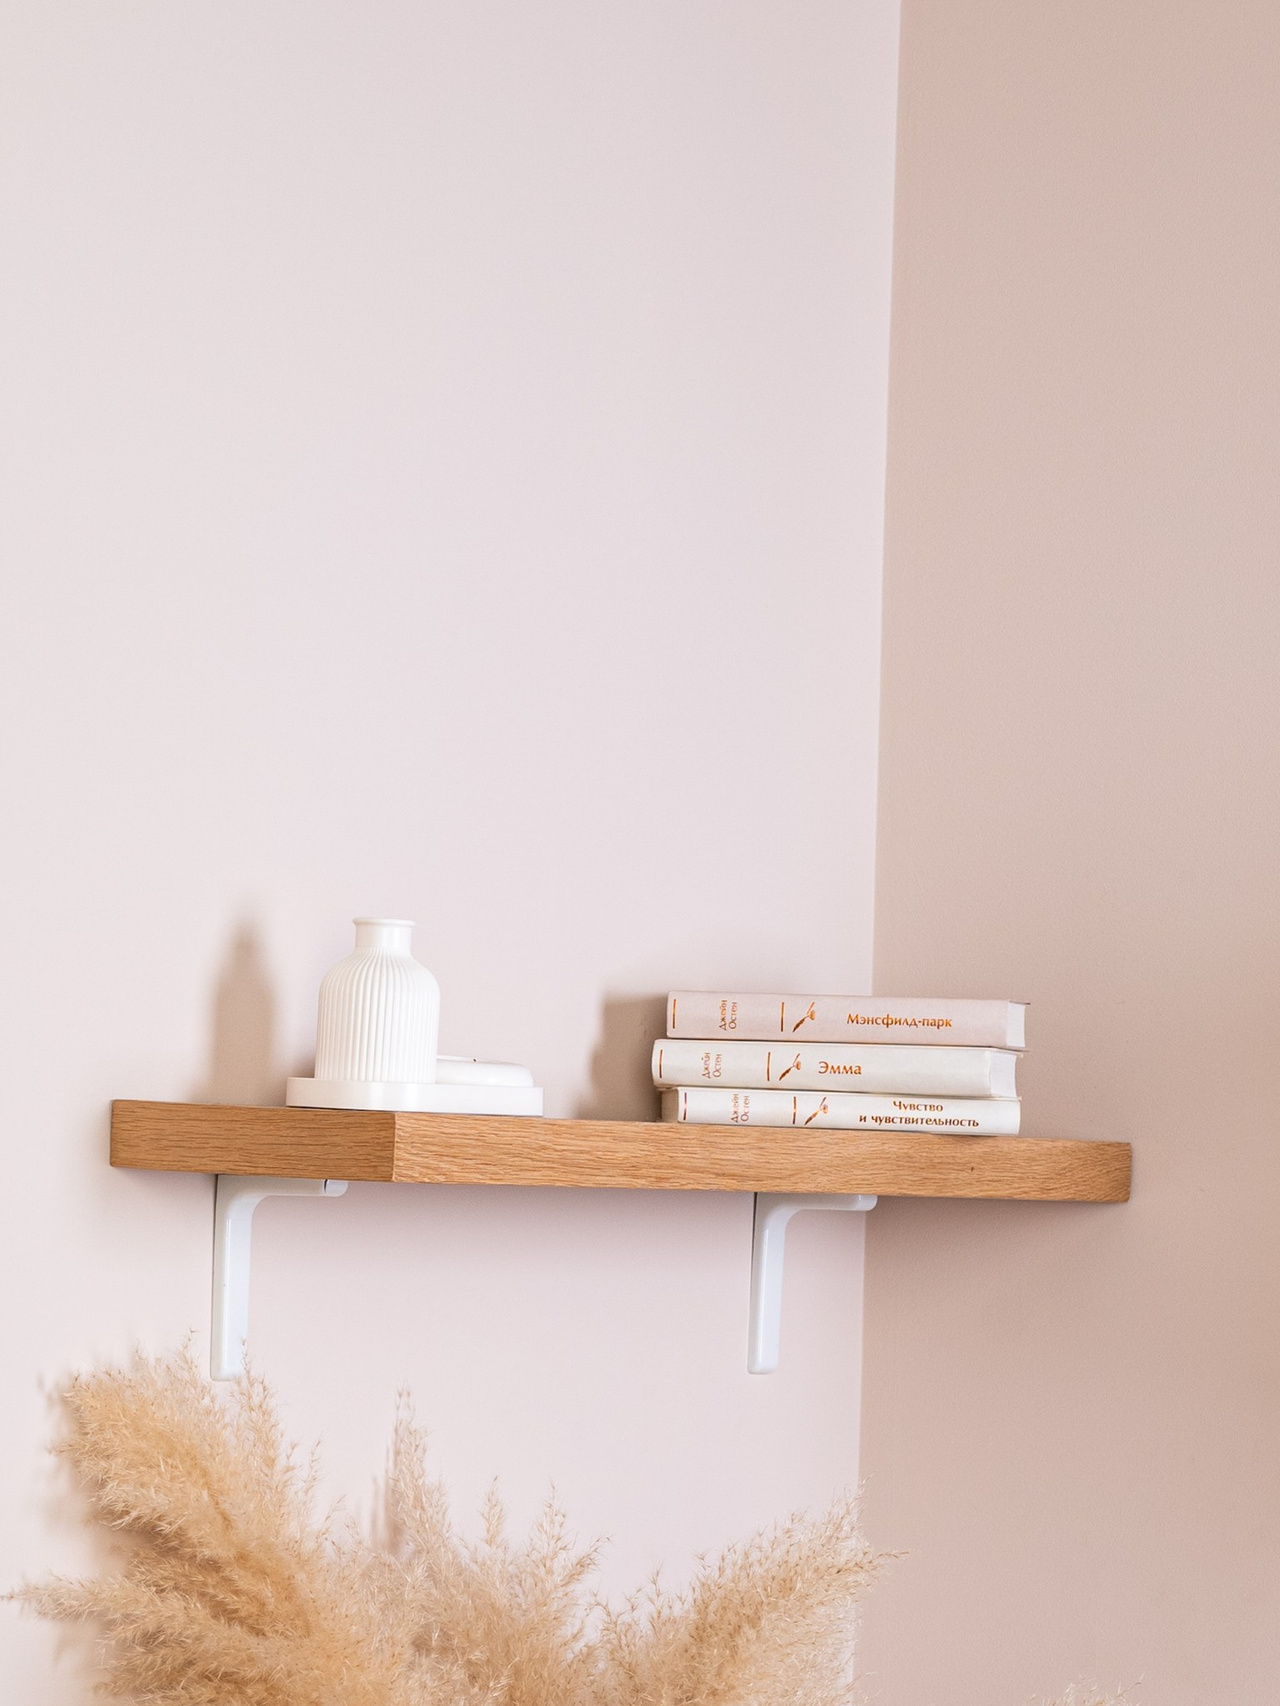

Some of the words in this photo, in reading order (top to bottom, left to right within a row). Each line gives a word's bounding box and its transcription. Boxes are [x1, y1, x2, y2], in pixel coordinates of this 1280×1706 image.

[719, 1000, 728, 1030] Джейн
[728, 1002, 738, 1030] Остен
[846, 1013, 952, 1030] Мэнсфилд-парк
[713, 1054, 722, 1078] Остен
[818, 1061, 862, 1074] Эмма
[740, 1096, 750, 1122] Остен
[893, 1100, 944, 1112] Чувство
[871, 1115, 979, 1127] чувствительность
